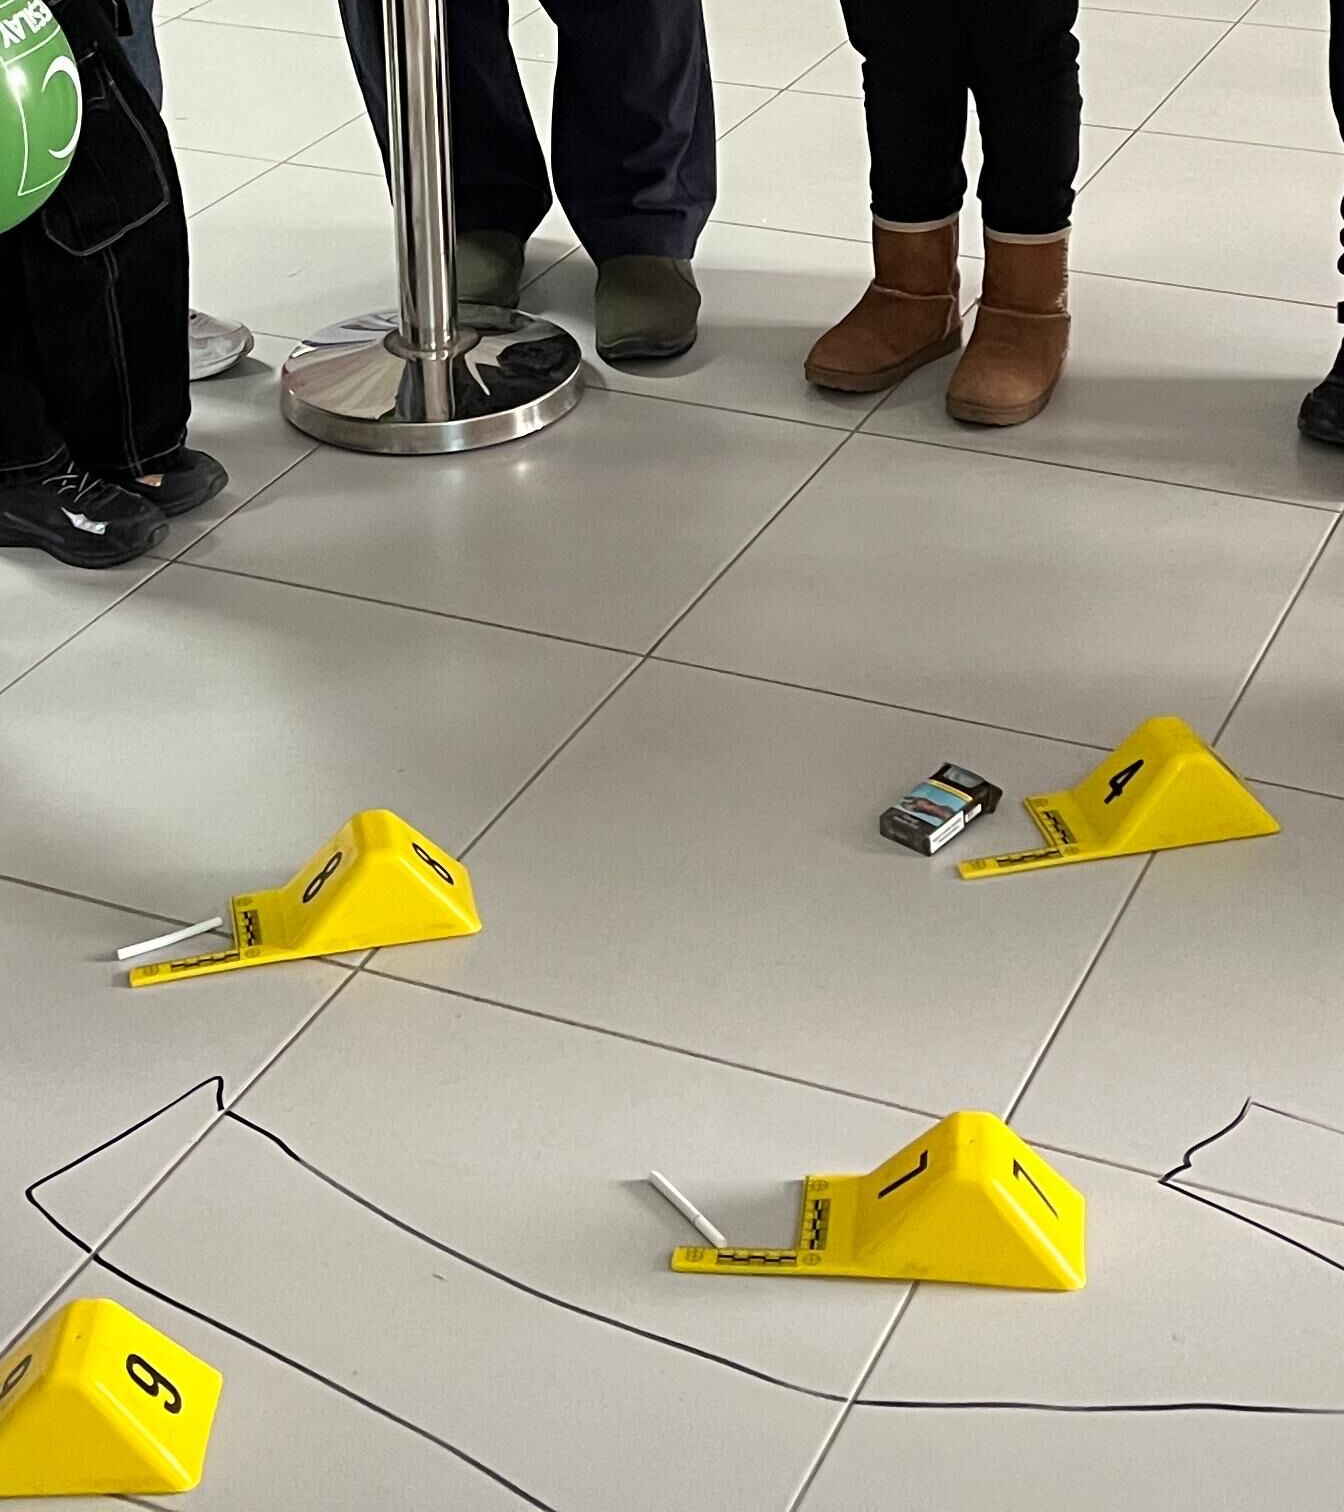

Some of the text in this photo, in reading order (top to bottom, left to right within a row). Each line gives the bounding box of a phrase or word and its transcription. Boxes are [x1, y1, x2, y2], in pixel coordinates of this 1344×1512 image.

[1103, 759, 1146, 805] 4
[301, 850, 343, 905] 8
[411, 841, 455, 887] 8
[125, 1353, 184, 1415] 9
